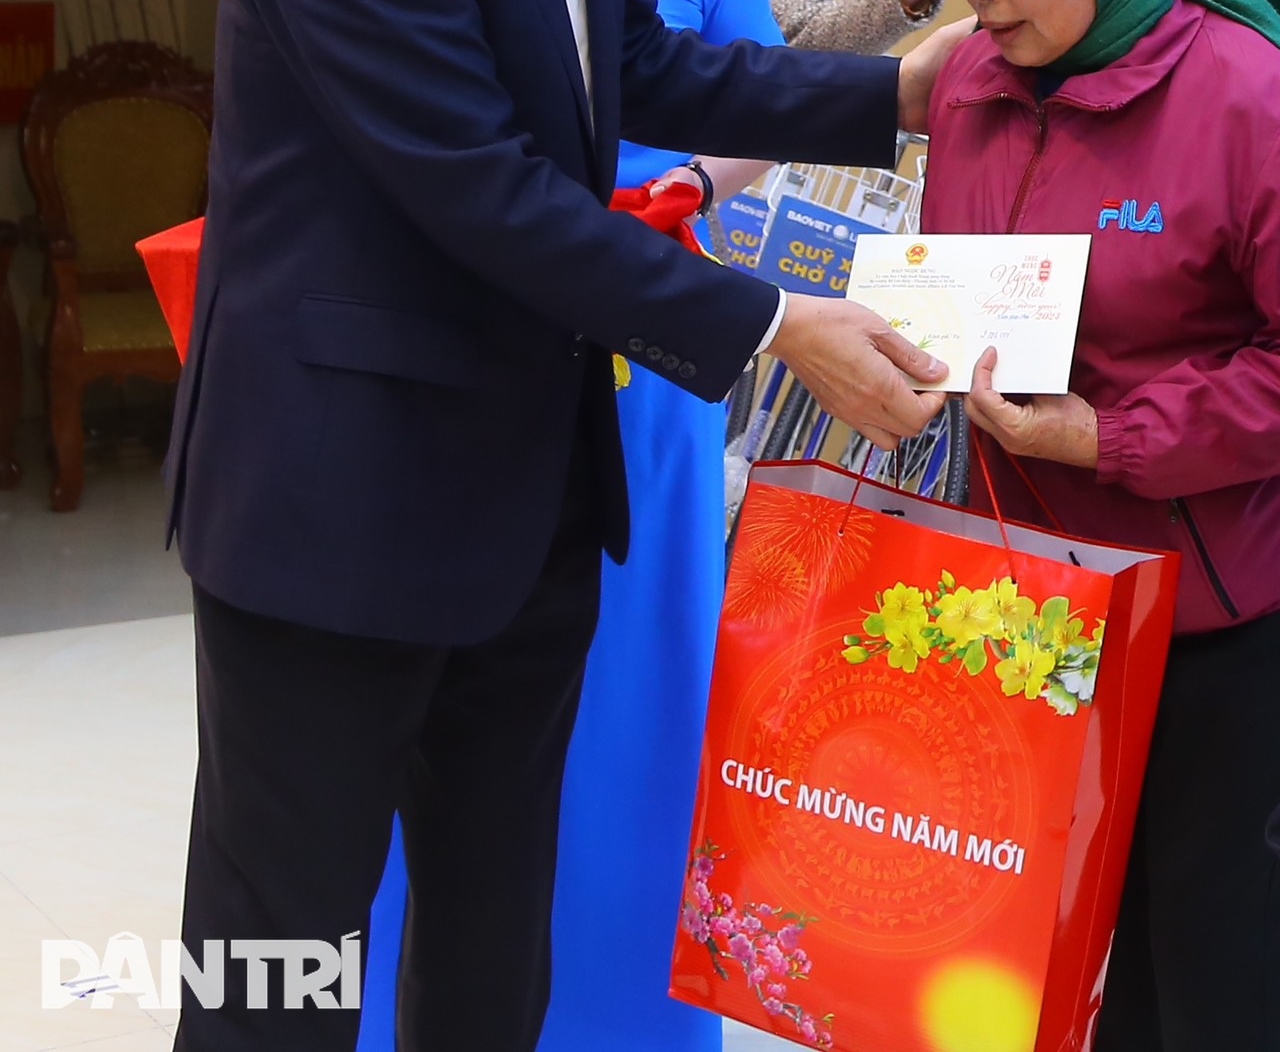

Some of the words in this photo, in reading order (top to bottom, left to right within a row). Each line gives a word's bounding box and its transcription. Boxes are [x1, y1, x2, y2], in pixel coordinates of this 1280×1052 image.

[1099, 199, 1163, 232] FILA
[730, 229, 760, 247] QU
[720, 759, 793, 805] CHÚC
[796, 784, 886, 834] MỪNG
[891, 812, 960, 857] NĂM
[964, 834, 1027, 875] MỚI
